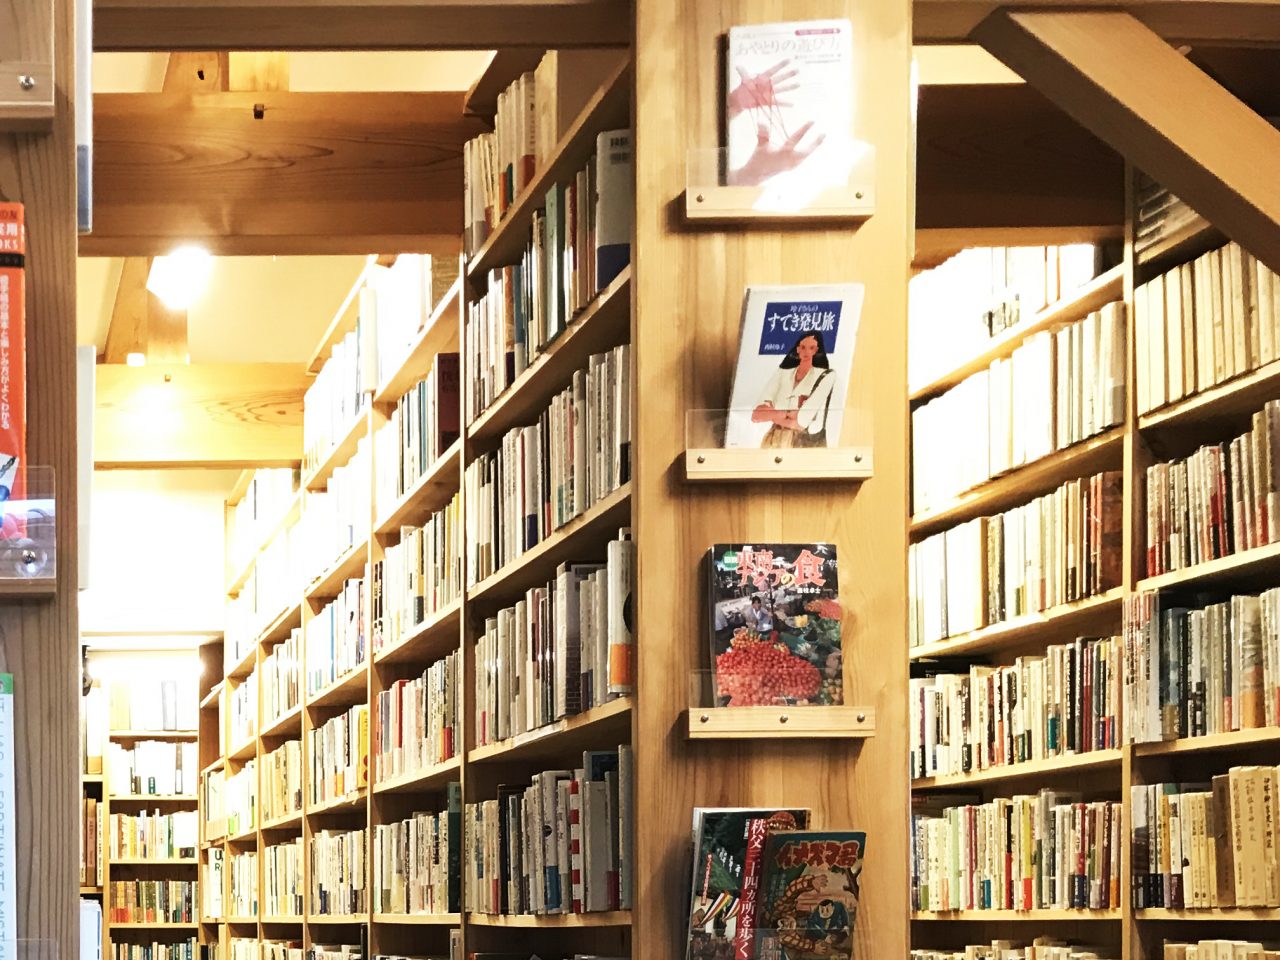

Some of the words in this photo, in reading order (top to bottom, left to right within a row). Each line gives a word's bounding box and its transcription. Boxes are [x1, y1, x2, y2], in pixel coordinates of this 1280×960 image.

[767, 311, 836, 332] すてき発見旅
